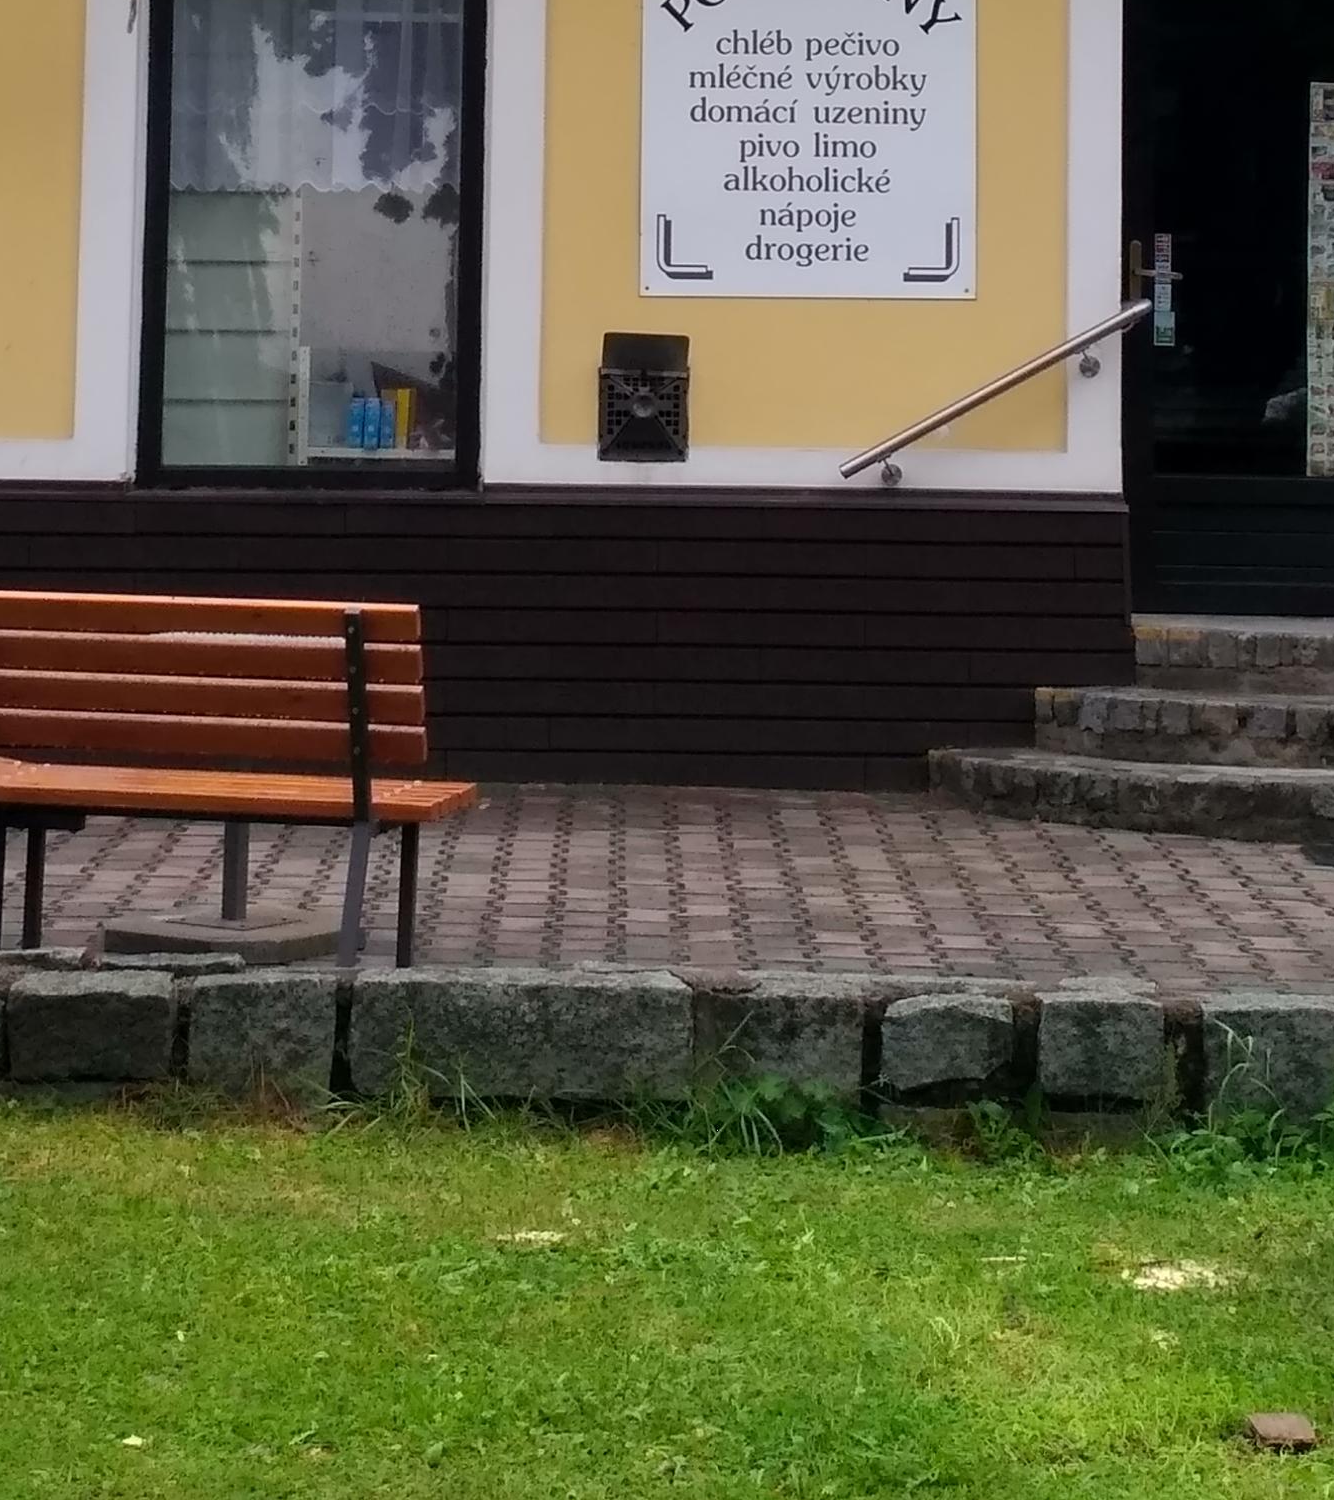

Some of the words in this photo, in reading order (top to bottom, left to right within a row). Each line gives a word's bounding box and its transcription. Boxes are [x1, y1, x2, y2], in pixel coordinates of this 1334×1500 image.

[716, 29, 792, 56] chléb
[805, 32, 900, 61] pečivo
[689, 63, 793, 89] mléčné
[805, 64, 927, 97] výrobky
[690, 96, 798, 123] domácí
[813, 101, 927, 132] uzeniny
[739, 133, 800, 162] pivo
[814, 132, 877, 158] limo
[723, 166, 891, 193] alkoholické
[760, 202, 857, 233] nápoje
[745, 235, 869, 267] drogerie
